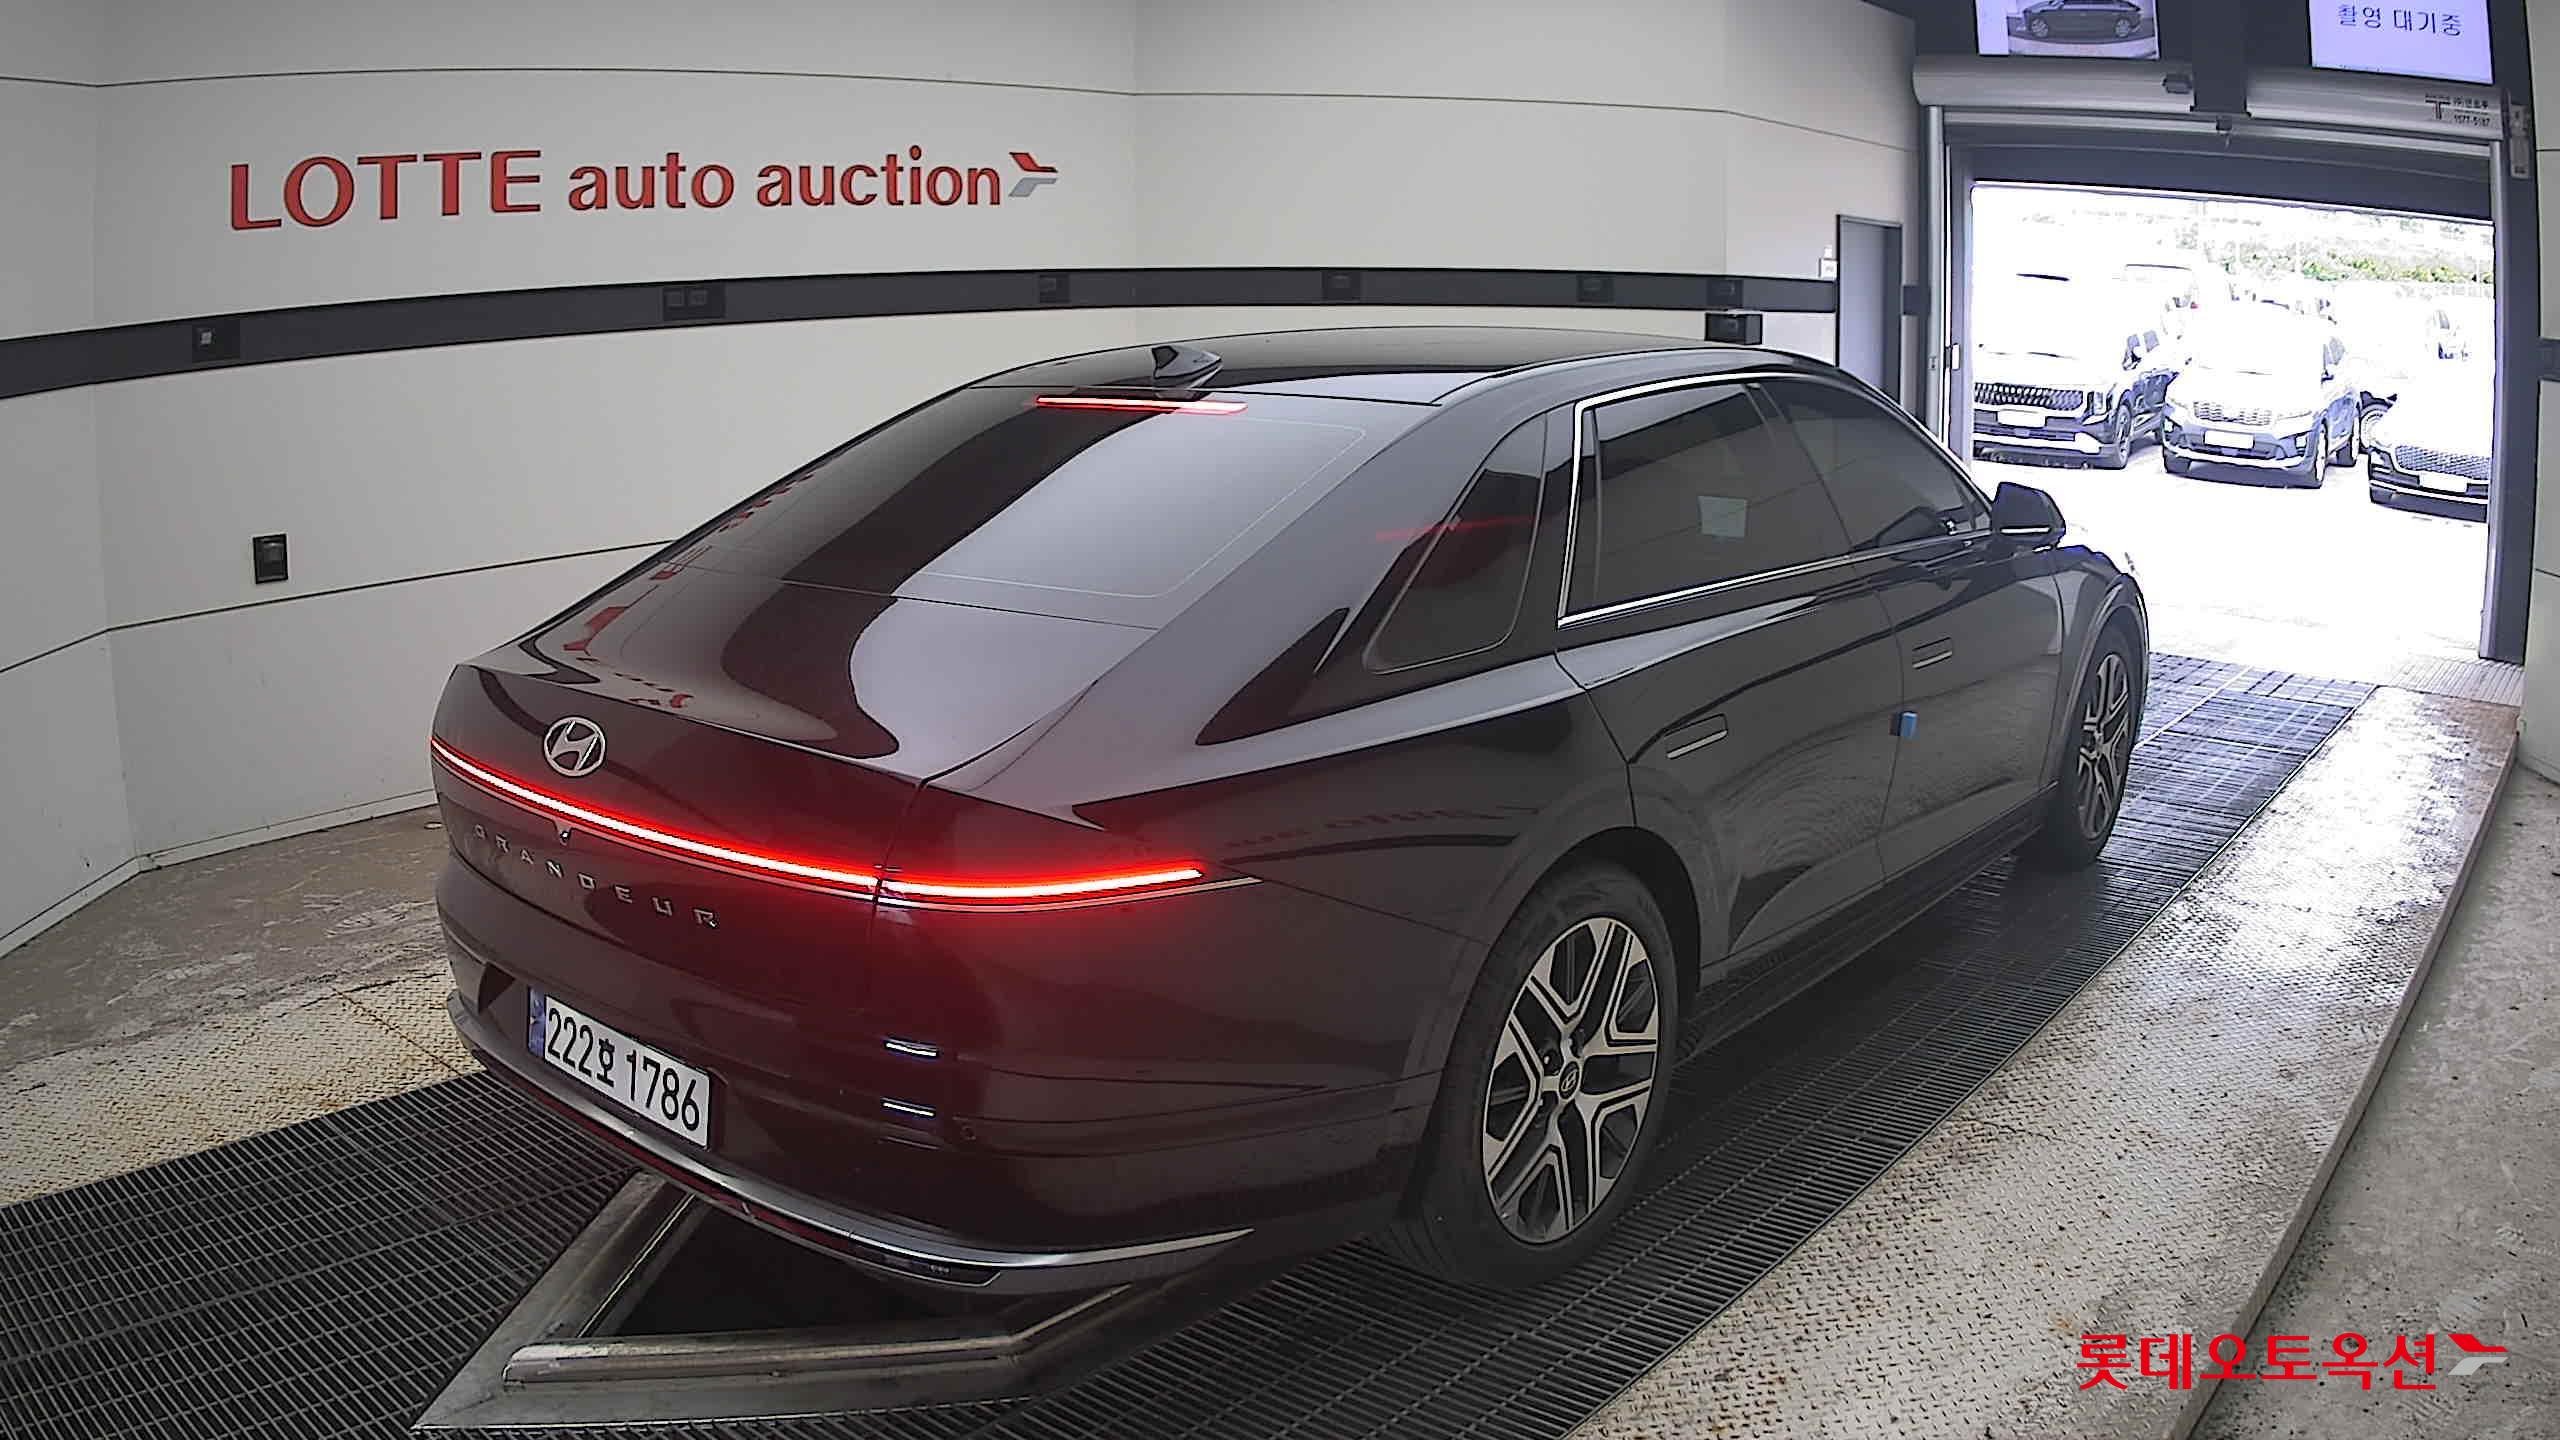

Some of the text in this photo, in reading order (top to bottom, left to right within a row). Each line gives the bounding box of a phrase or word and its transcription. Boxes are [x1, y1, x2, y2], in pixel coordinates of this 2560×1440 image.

[2393, 9, 2462, 36] 대기중
[231, 145, 1001, 231] LOTTE auto auction
[474, 823, 718, 928] GRANDEUR
[547, 1007, 700, 1131] 222호 1786
